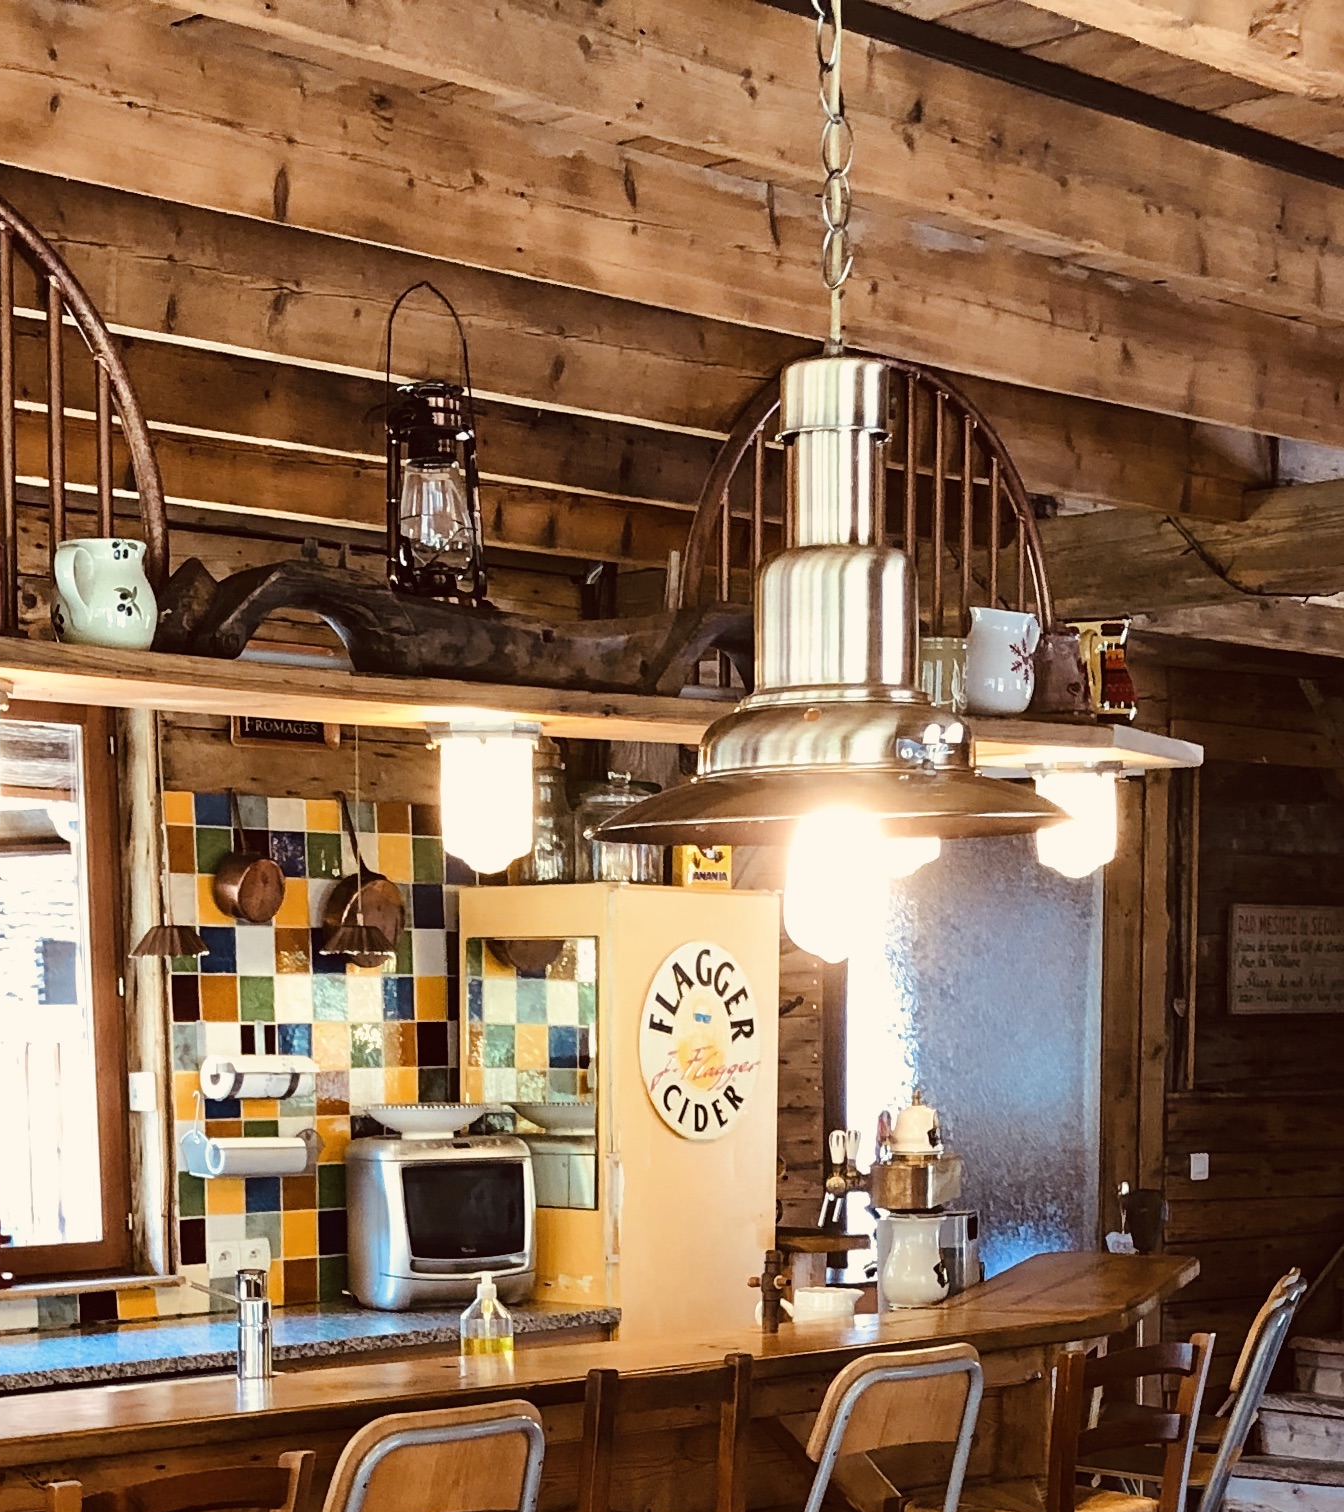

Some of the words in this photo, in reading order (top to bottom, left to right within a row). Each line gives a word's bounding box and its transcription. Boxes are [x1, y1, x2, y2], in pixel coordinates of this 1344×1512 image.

[245, 716, 318, 735] FROMAGES
[688, 871, 728, 881] ANANIA
[649, 949, 754, 1043] FLAGGER
[681, 1045, 761, 1092] Flagger
[663, 1084, 745, 1132] CIDER
